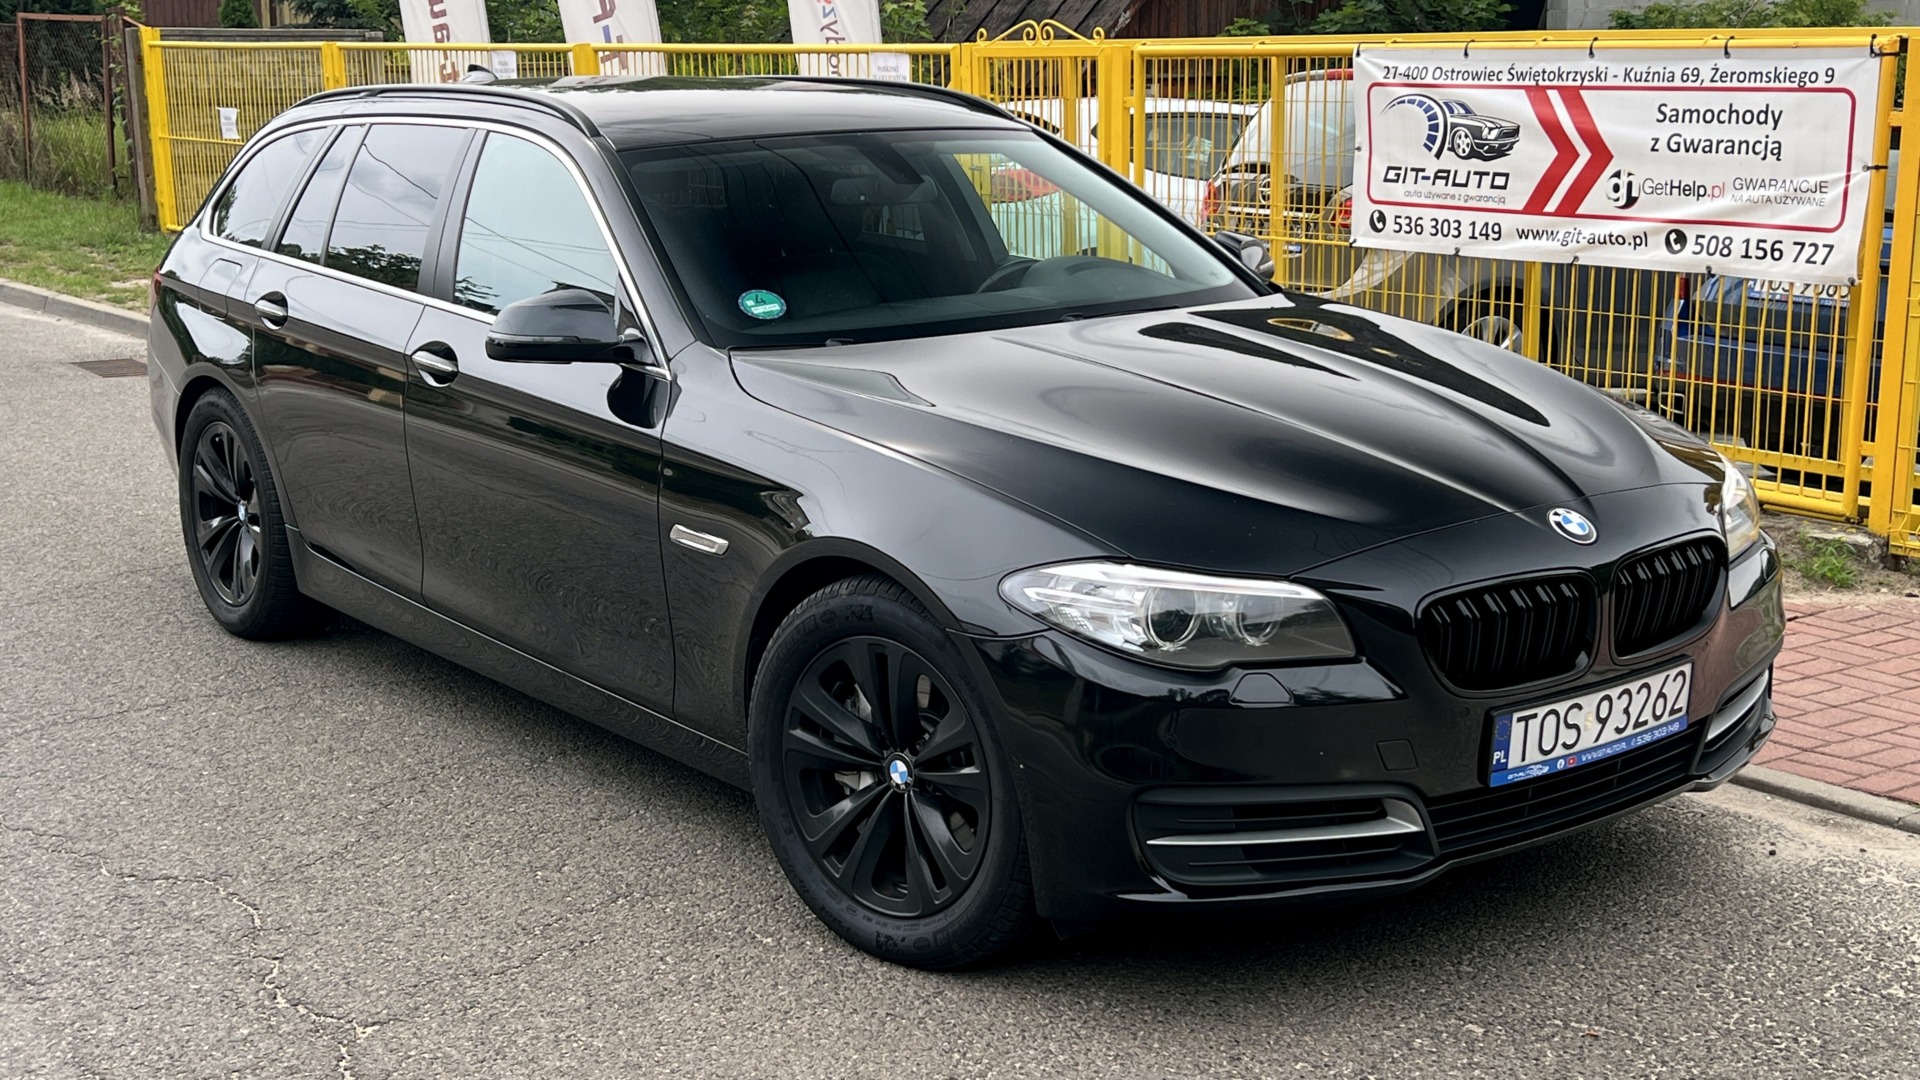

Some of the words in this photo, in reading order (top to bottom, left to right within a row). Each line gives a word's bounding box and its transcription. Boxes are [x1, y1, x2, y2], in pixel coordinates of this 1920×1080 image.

[1383, 66, 1428, 80] 27-400
[1432, 66, 1503, 81] Ostrowiec
[1507, 63, 1608, 86] Świętokrzyski
[1623, 66, 1675, 83] Kuźnia
[1680, 67, 1705, 85] 69,
[1709, 63, 1819, 87] Żeromskiego
[1824, 67, 1835, 84] 9
[1656, 103, 1783, 130] Samochody
[1650, 137, 1660, 152] z
[1666, 133, 1782, 161] Gwarancją
[1383, 166, 1510, 190] GIT-AUTO
[1642, 177, 1725, 202] GetHelp.pl
[1732, 177, 1829, 194] GWARANCJE
[1404, 190, 1422, 198] auta
[1423, 190, 1456, 202] używane
[1463, 193, 1506, 206] gwarancją
[1731, 193, 1743, 203] NA
[1745, 195, 1773, 204] AUTA
[1774, 194, 1826, 207] UŻYWANE
[1393, 215, 1424, 236] 536
[1429, 218, 1462, 238] 303
[1468, 220, 1502, 242] 149
[1516, 226, 1649, 250] www.git-auto.pl
[1692, 234, 1733, 257] 508
[1740, 237, 1784, 261] 156
[1792, 241, 1835, 266] 727
[1516, 702, 1584, 762] TOS
[1594, 670, 1687, 743] 93262
[1493, 750, 1507, 764] PL
